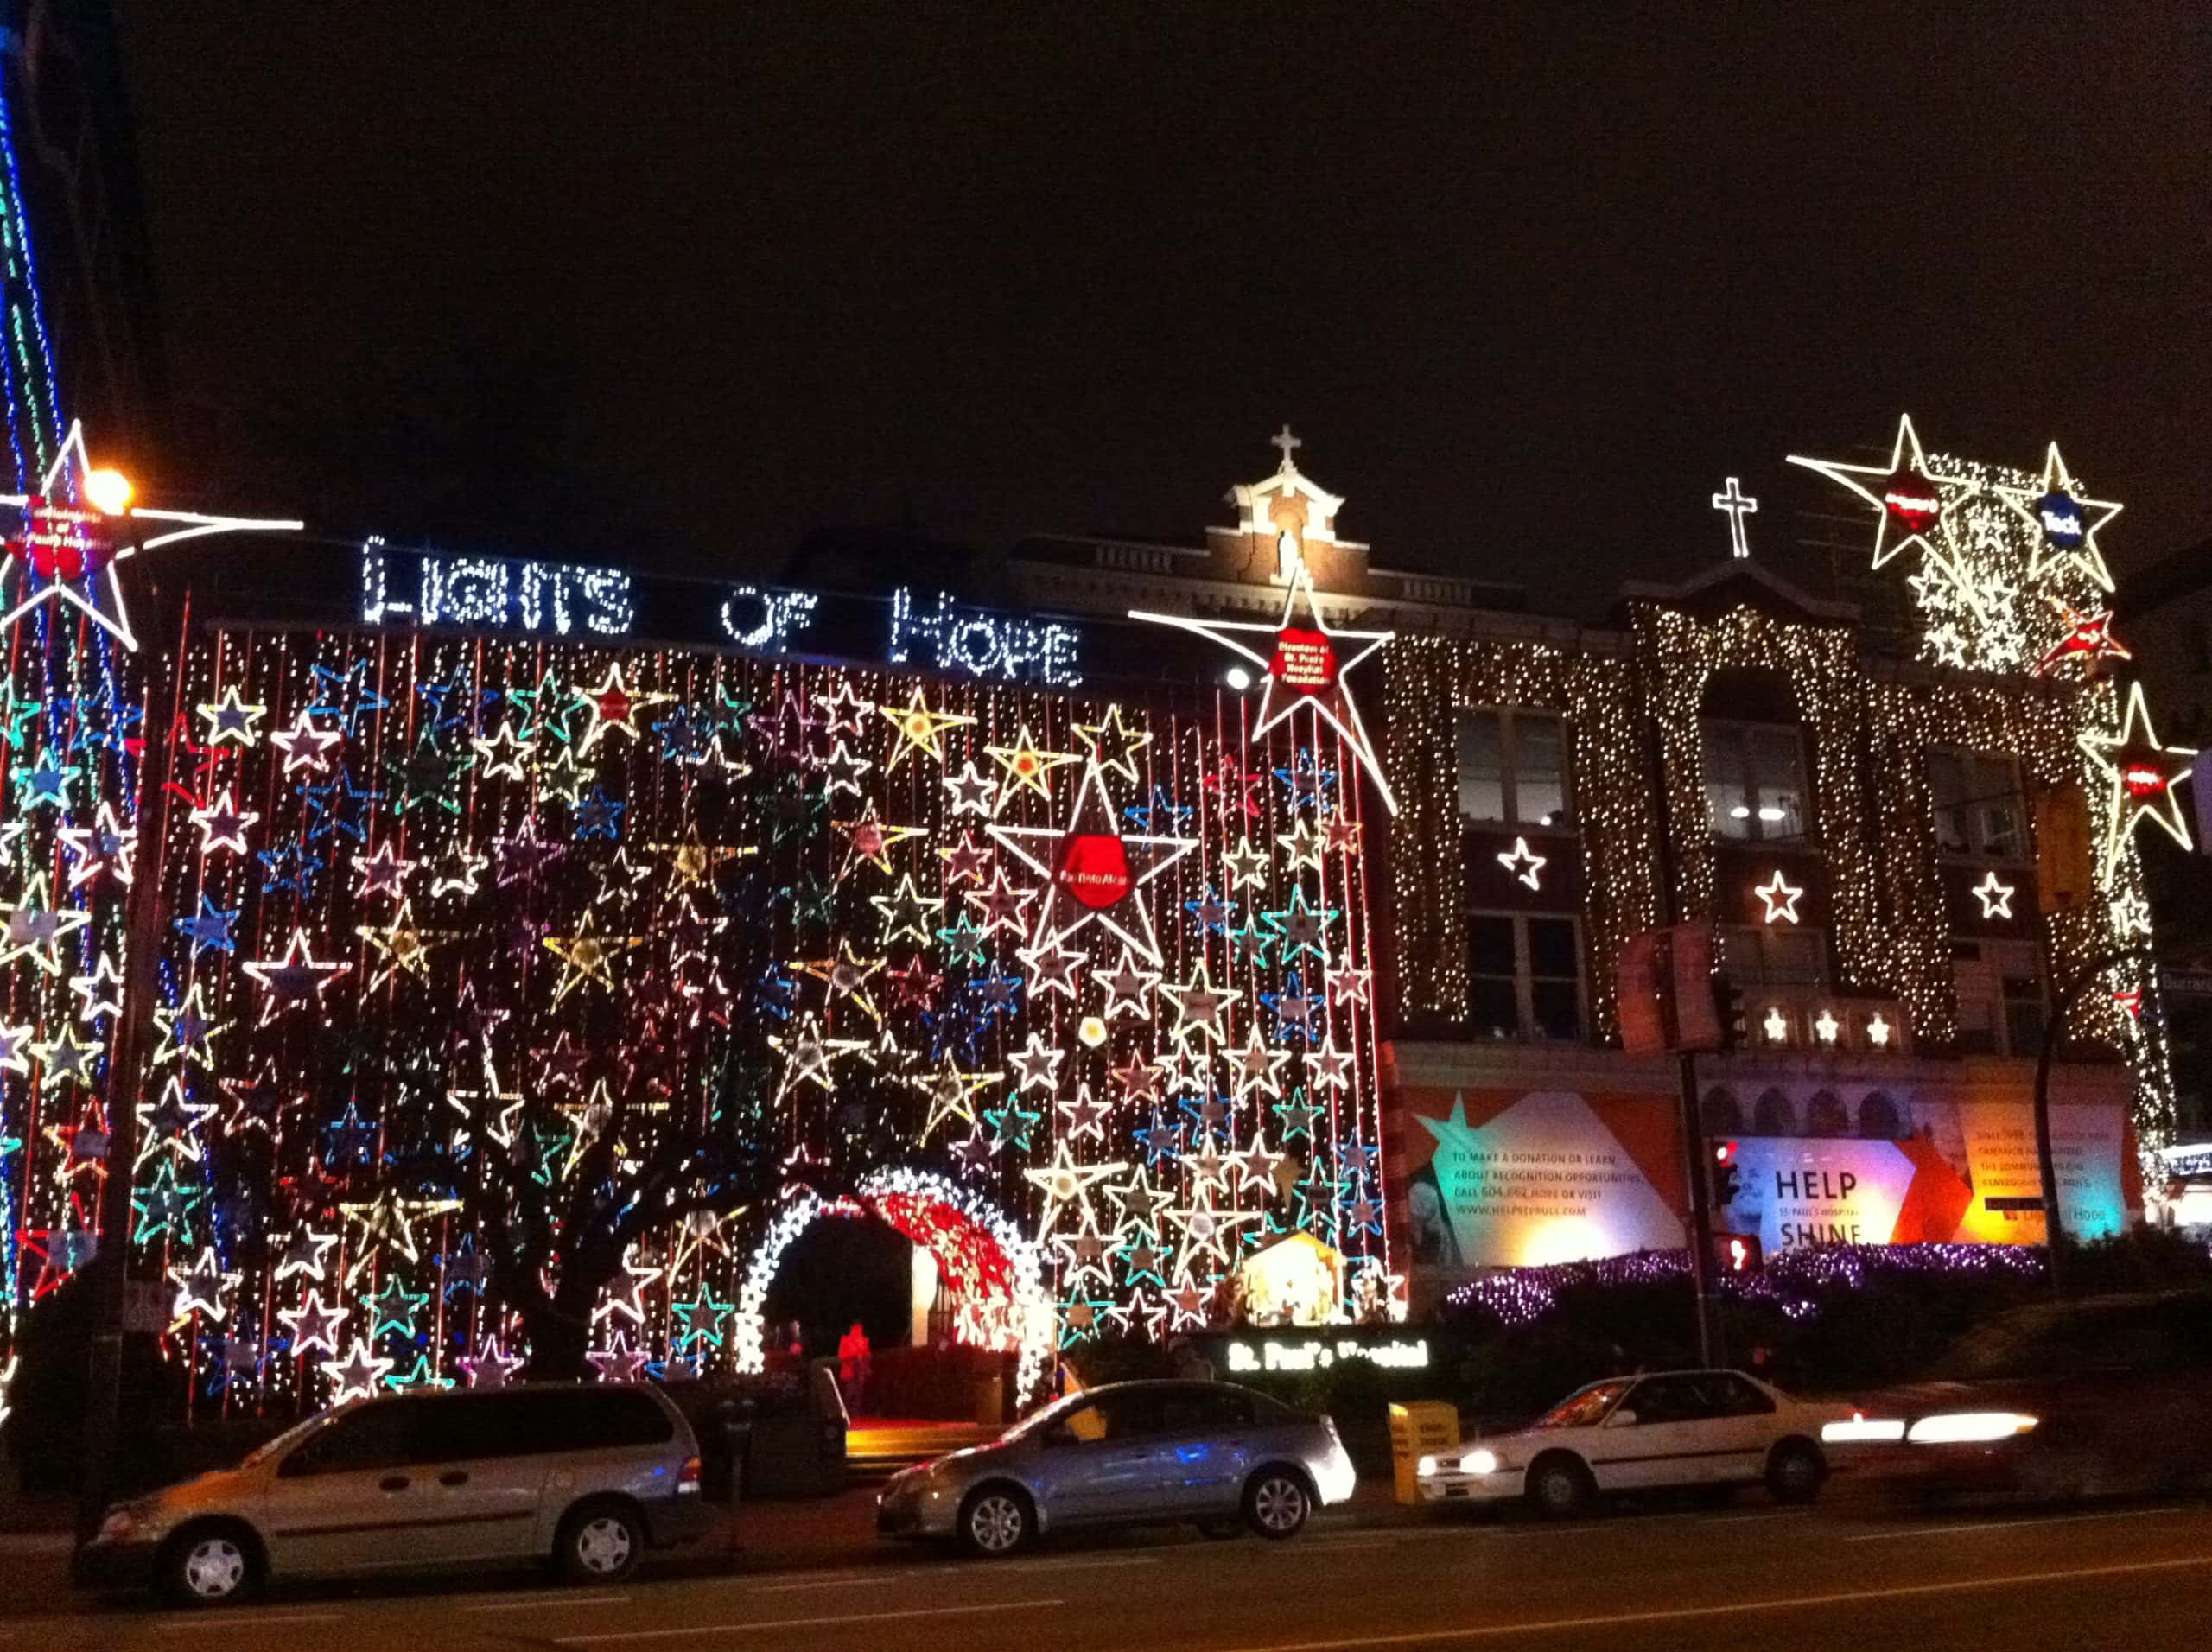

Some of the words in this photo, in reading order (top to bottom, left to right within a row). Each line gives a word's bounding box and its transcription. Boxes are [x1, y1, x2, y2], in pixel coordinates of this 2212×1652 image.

[890, 585, 1083, 687] HOPE
[1453, 1152, 1466, 1162] TO
[1470, 1153, 1499, 1163] MAKE
[1502, 1153, 1509, 1163] A
[1512, 1153, 1566, 1164] DONATION
[1568, 1154, 1582, 1164] OR
[1585, 1154, 1617, 1165] LEARN
[1454, 1170, 1490, 1182] ABOUT
[1492, 1170, 1563, 1183] RECOGNITION
[1775, 1170, 1857, 1200] HELP
[1454, 1187, 1478, 1198] CALL
[1561, 1189, 1574, 1200] OR
[1578, 1189, 1602, 1200] VISIT
[1780, 1223, 1861, 1246] SHINE
